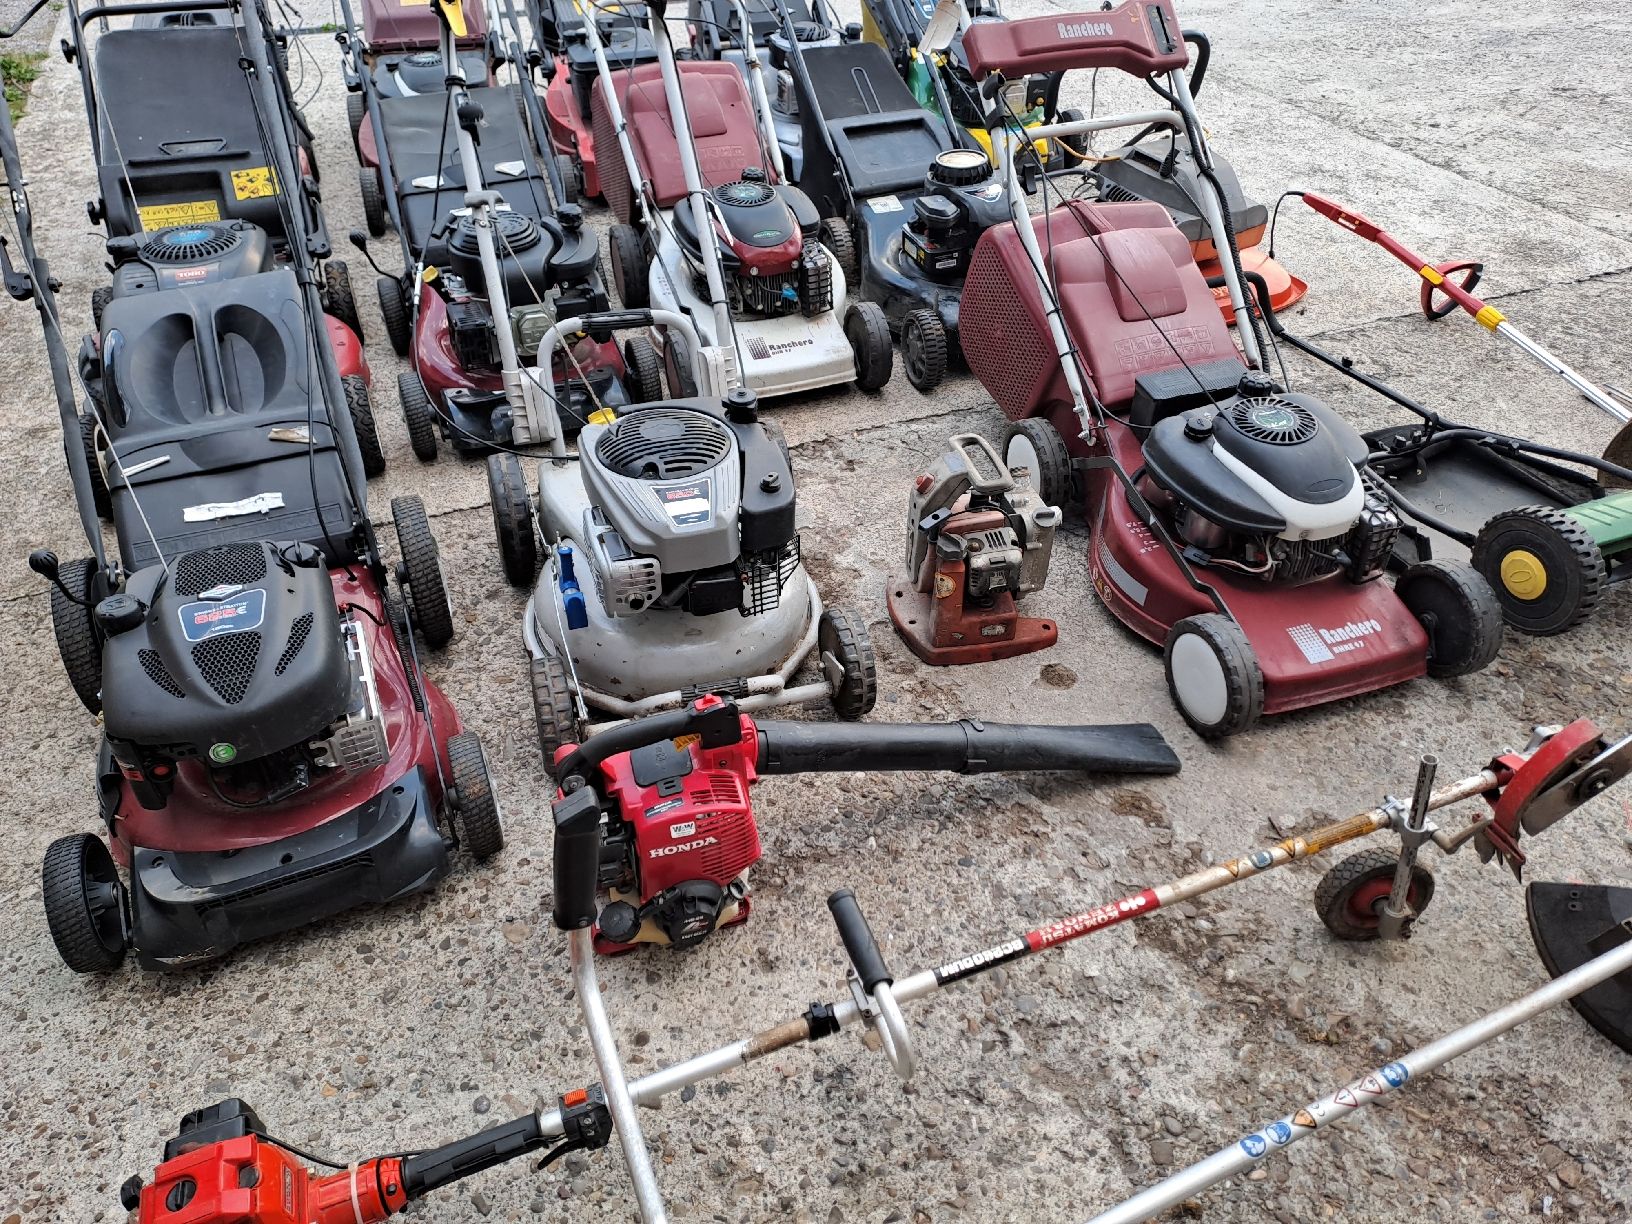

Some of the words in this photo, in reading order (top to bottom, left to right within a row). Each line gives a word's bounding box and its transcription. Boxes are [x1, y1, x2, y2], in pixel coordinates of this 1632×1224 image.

[1056, 21, 1113, 39] Ranchero
[768, 339, 814, 351] Ranchero
[1319, 619, 1382, 645] Ranchero
[649, 836, 718, 858] HONDA
[1041, 910, 1120, 944] KOMATSU
